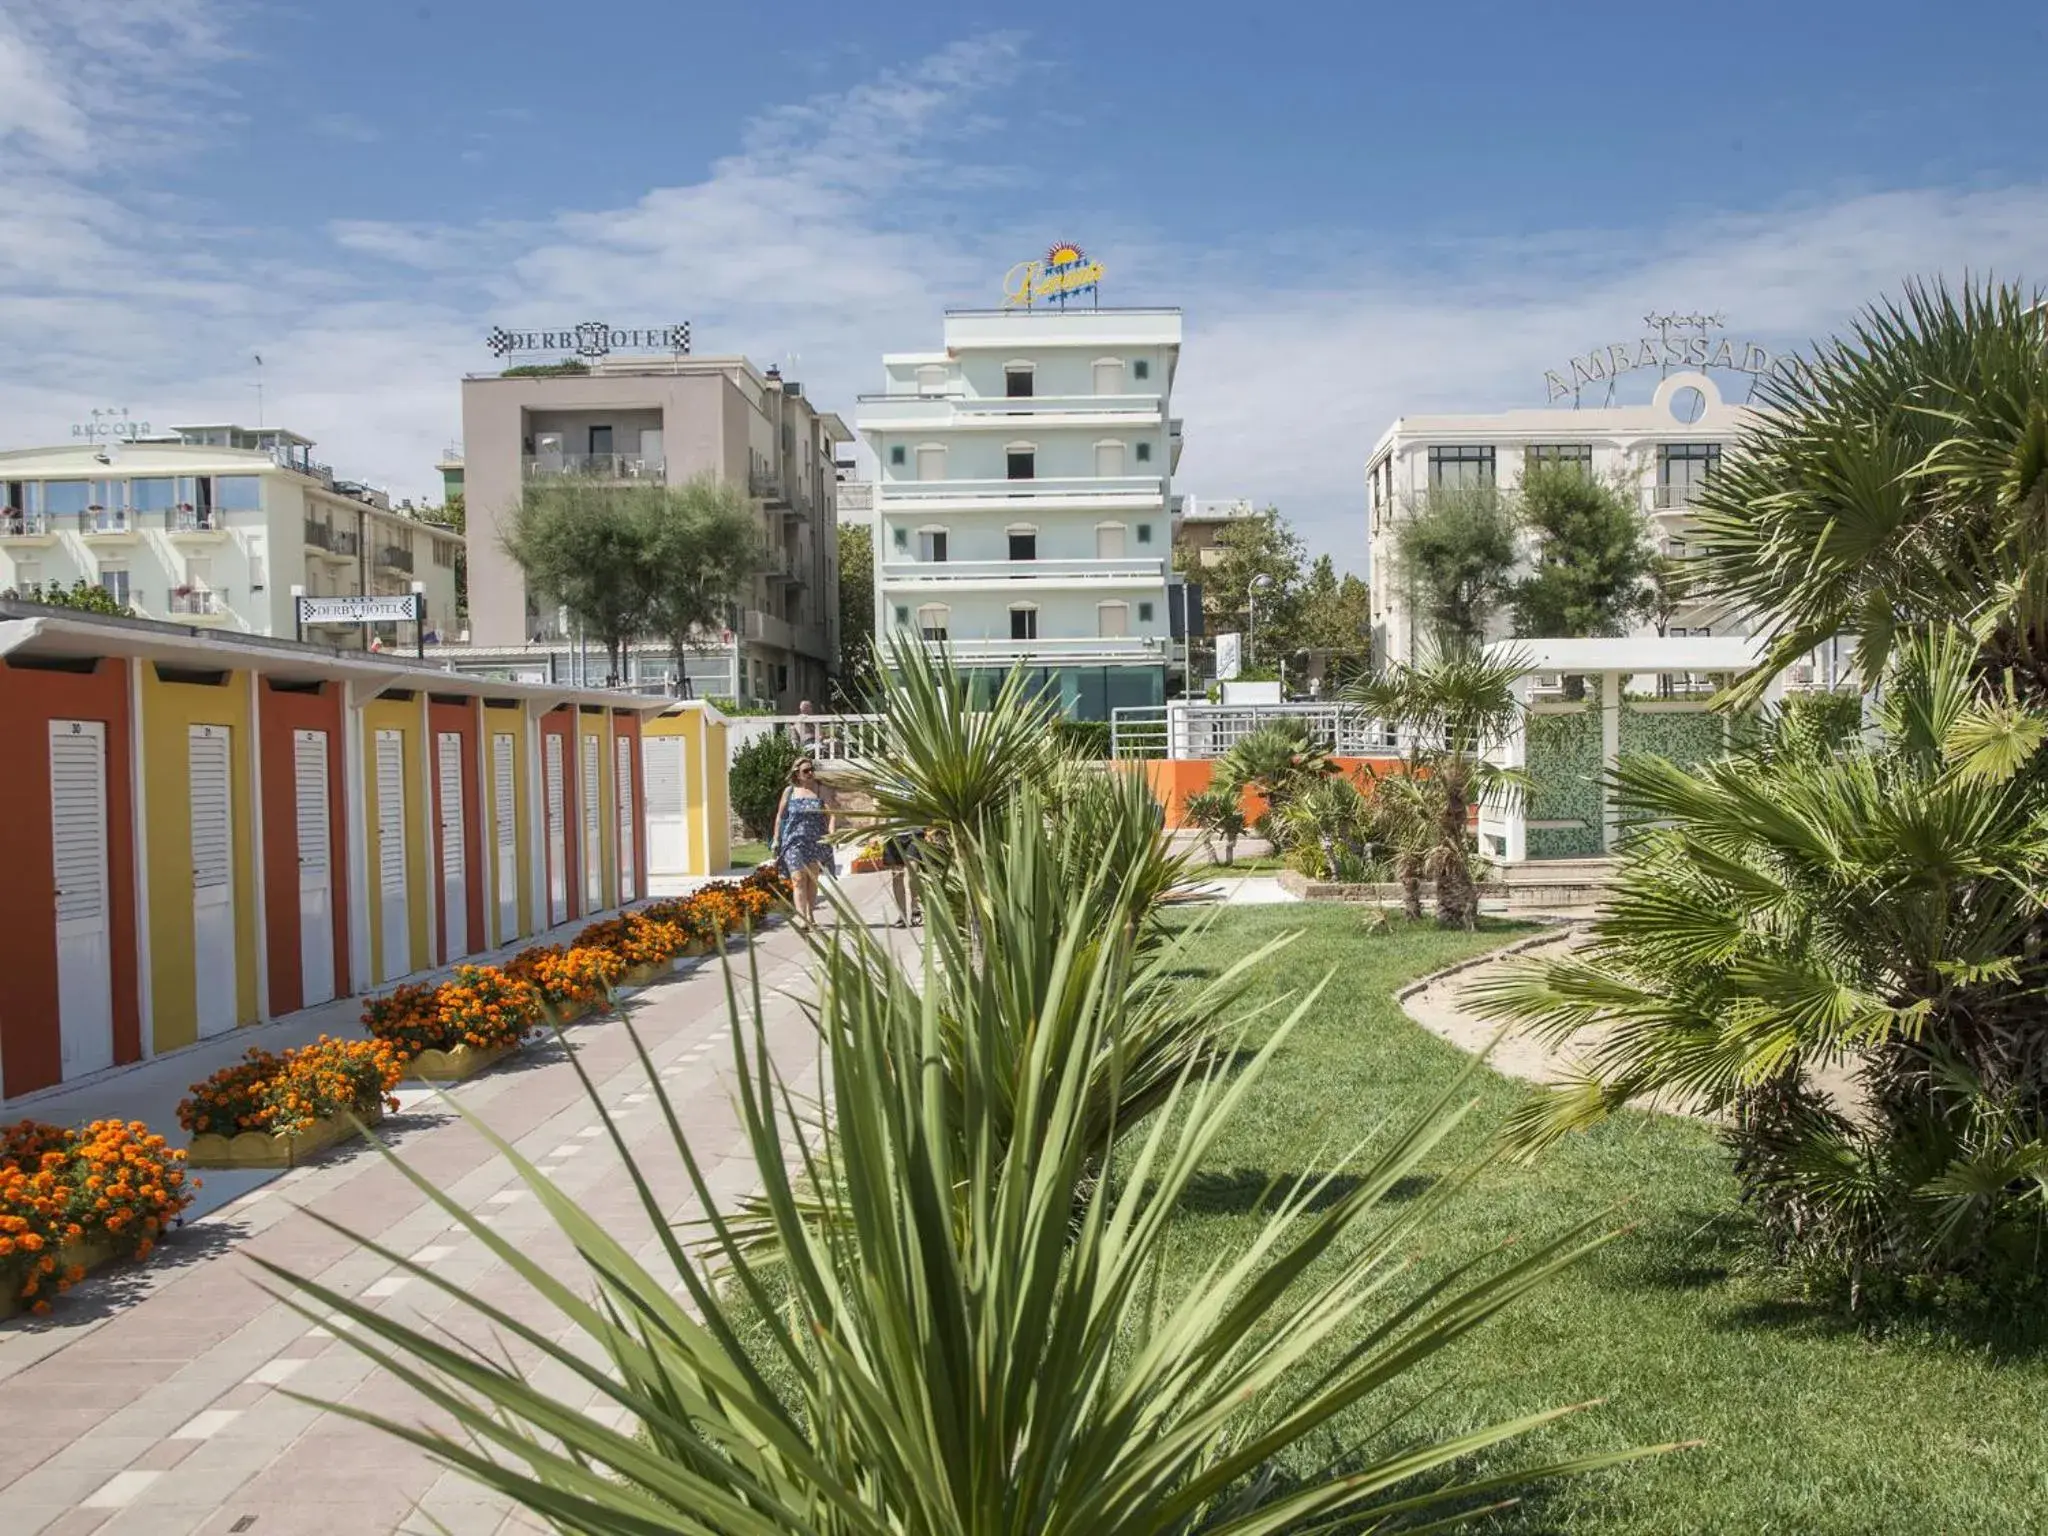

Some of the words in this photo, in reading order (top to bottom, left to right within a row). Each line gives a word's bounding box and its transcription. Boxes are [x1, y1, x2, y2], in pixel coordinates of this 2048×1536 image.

[508, 331, 585, 350] DERBY
[594, 328, 674, 348] HOTEL
[317, 604, 357, 616] DERBY
[362, 602, 400, 615] HOTEL
